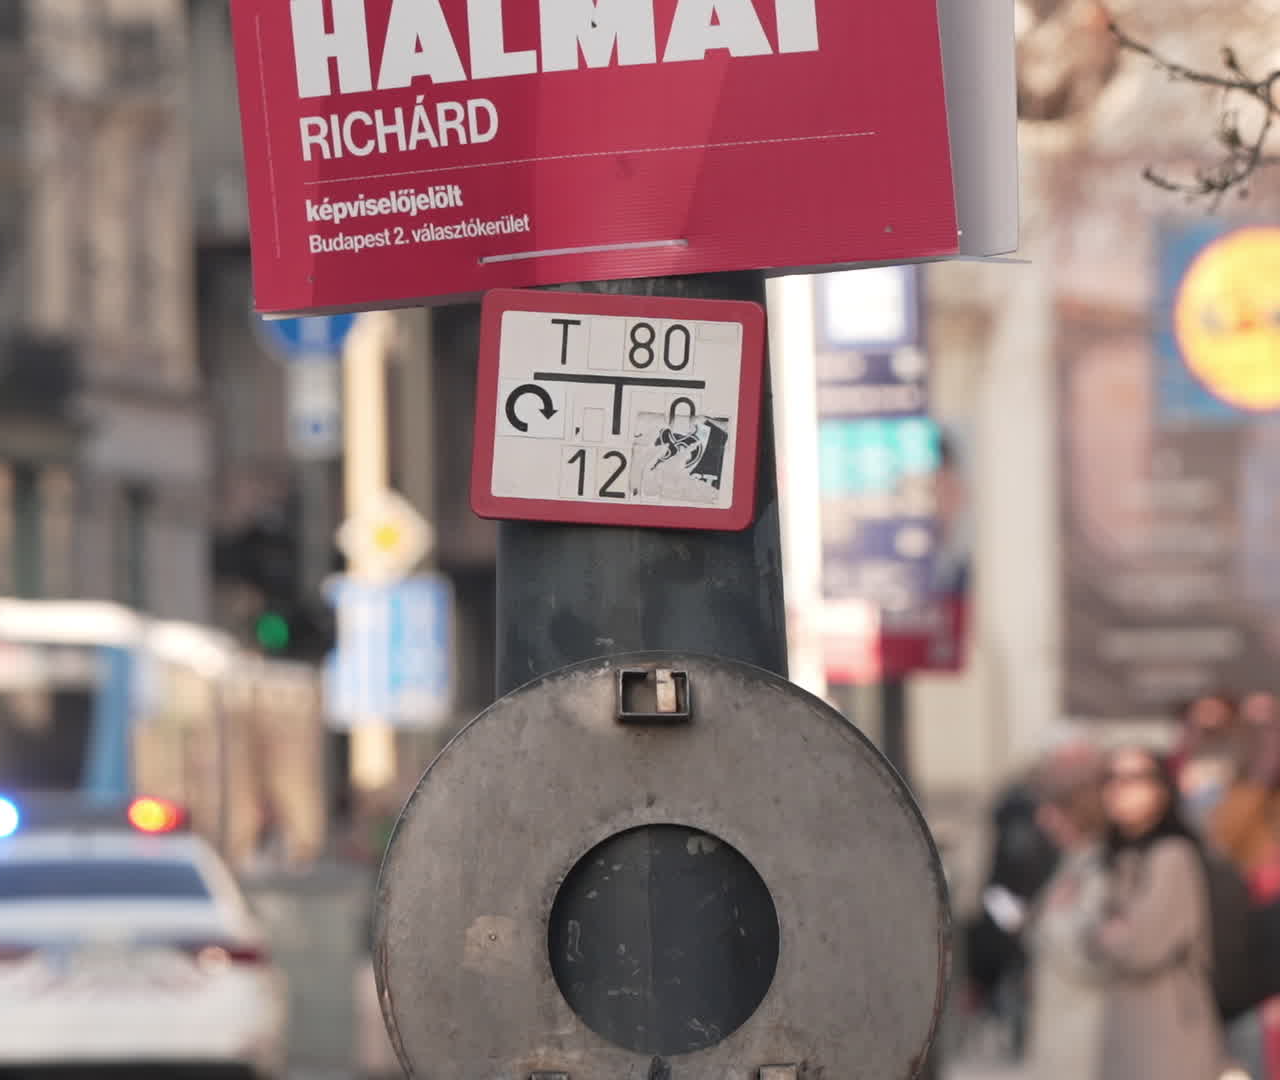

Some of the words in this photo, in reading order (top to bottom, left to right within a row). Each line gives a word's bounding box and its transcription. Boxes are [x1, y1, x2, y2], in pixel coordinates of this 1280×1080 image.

[299, 94, 499, 162] RICHÁRD
[305, 184, 463, 224] képviselőjelölt
[308, 229, 391, 254] Budapest
[394, 226, 409, 246] 2.
[412, 214, 531, 243] választókerület
[551, 319, 581, 365] T
[628, 322, 690, 371] 80
